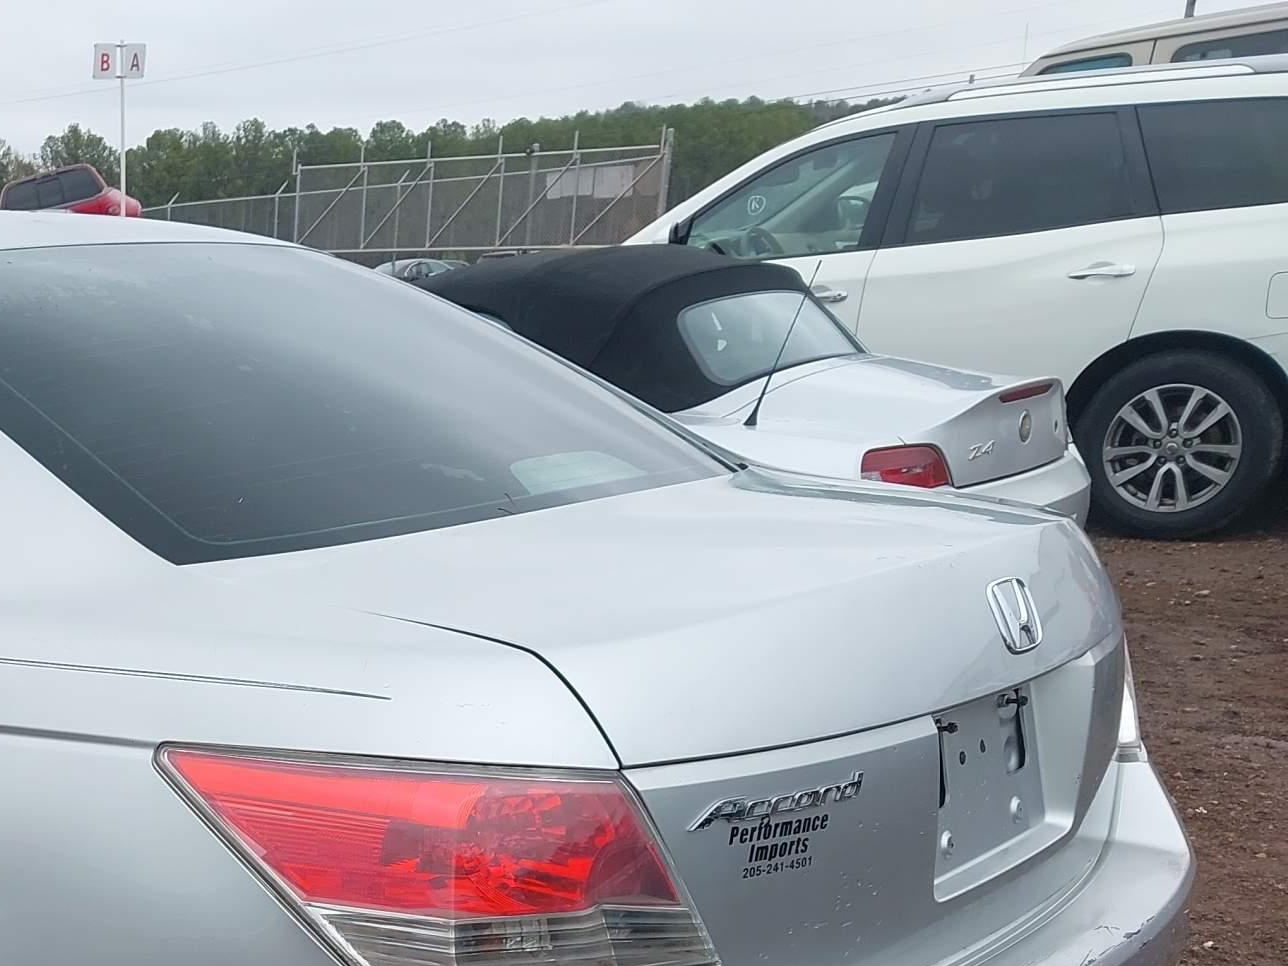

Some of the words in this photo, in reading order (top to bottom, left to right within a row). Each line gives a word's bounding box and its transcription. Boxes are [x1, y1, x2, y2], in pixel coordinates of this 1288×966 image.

[101, 53, 110, 71] B
[130, 53, 140, 71] A
[968, 440, 995, 460] Z4
[687, 769, 864, 832] Accord
[729, 814, 829, 845] Performance
[748, 837, 809, 863] Imports
[742, 856, 813, 879] 205-241-4501
